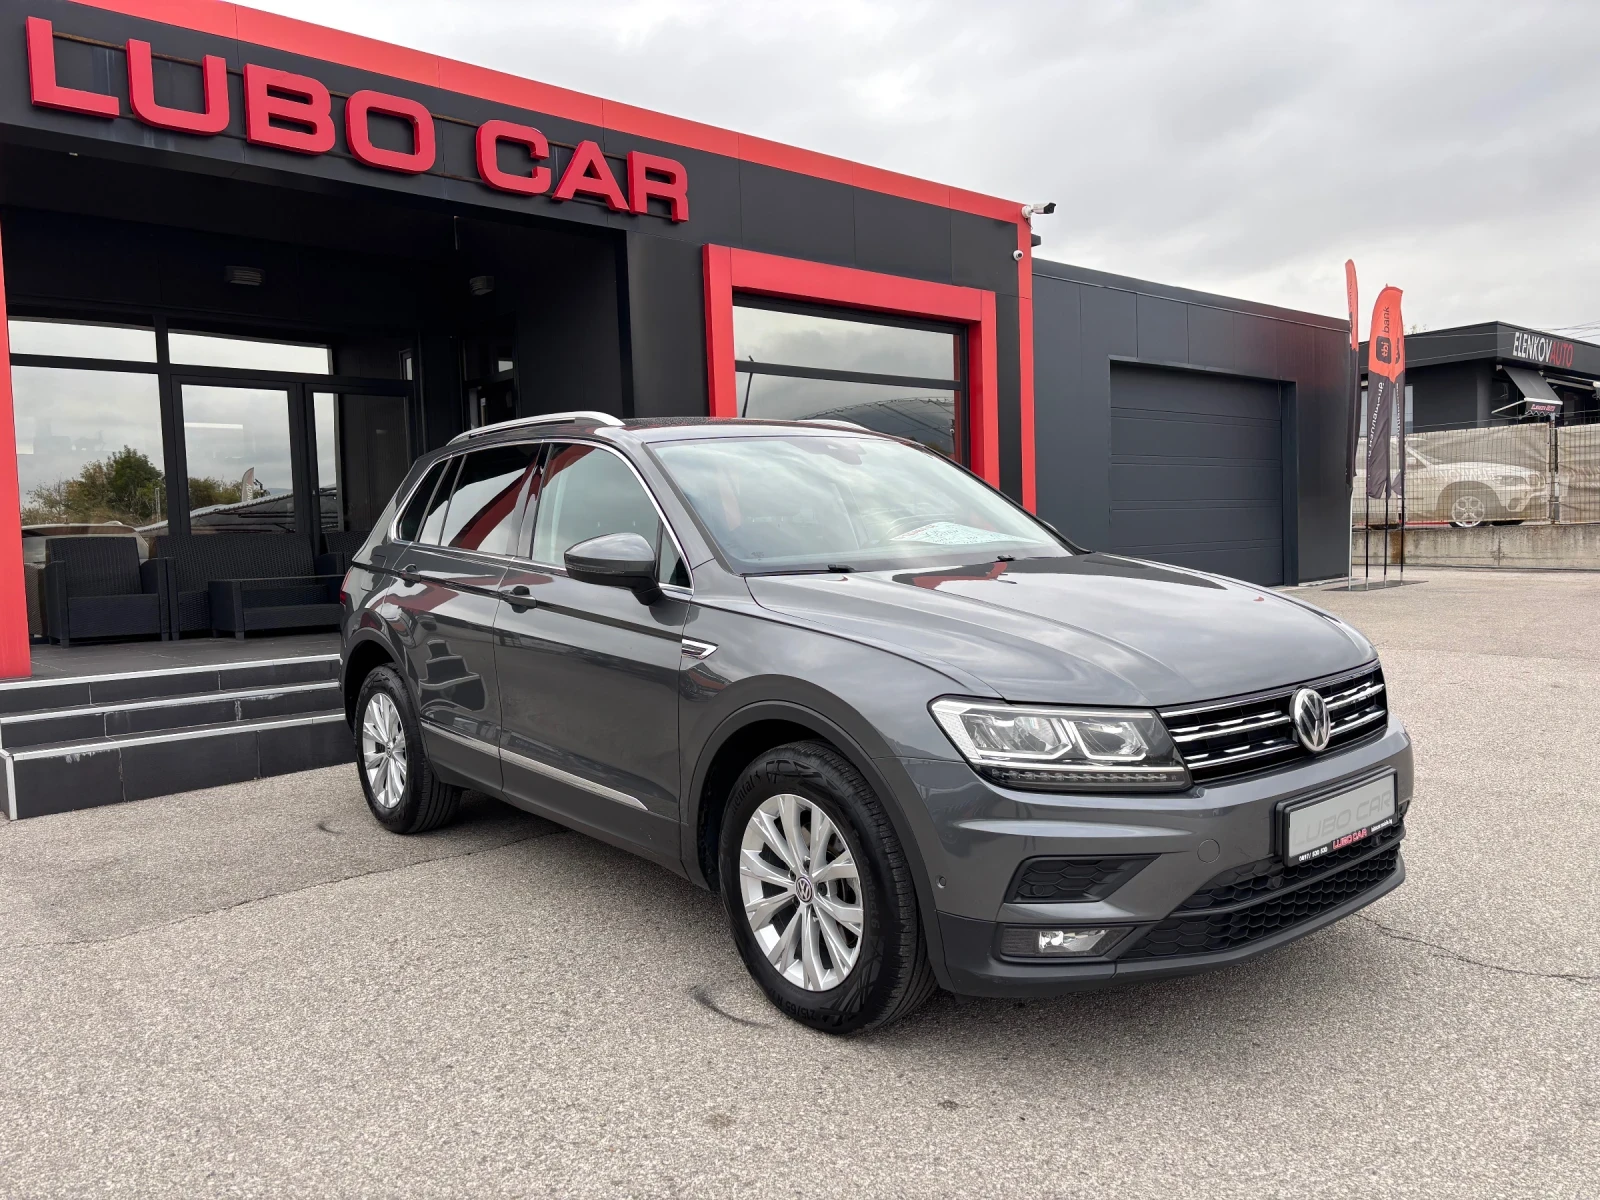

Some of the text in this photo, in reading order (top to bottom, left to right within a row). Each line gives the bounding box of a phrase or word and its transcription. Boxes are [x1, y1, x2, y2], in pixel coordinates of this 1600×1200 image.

[25, 16, 690, 223] LUBO CAR
[1382, 306, 1390, 334] bank
[1292, 789, 1393, 846] LUBO CAR
